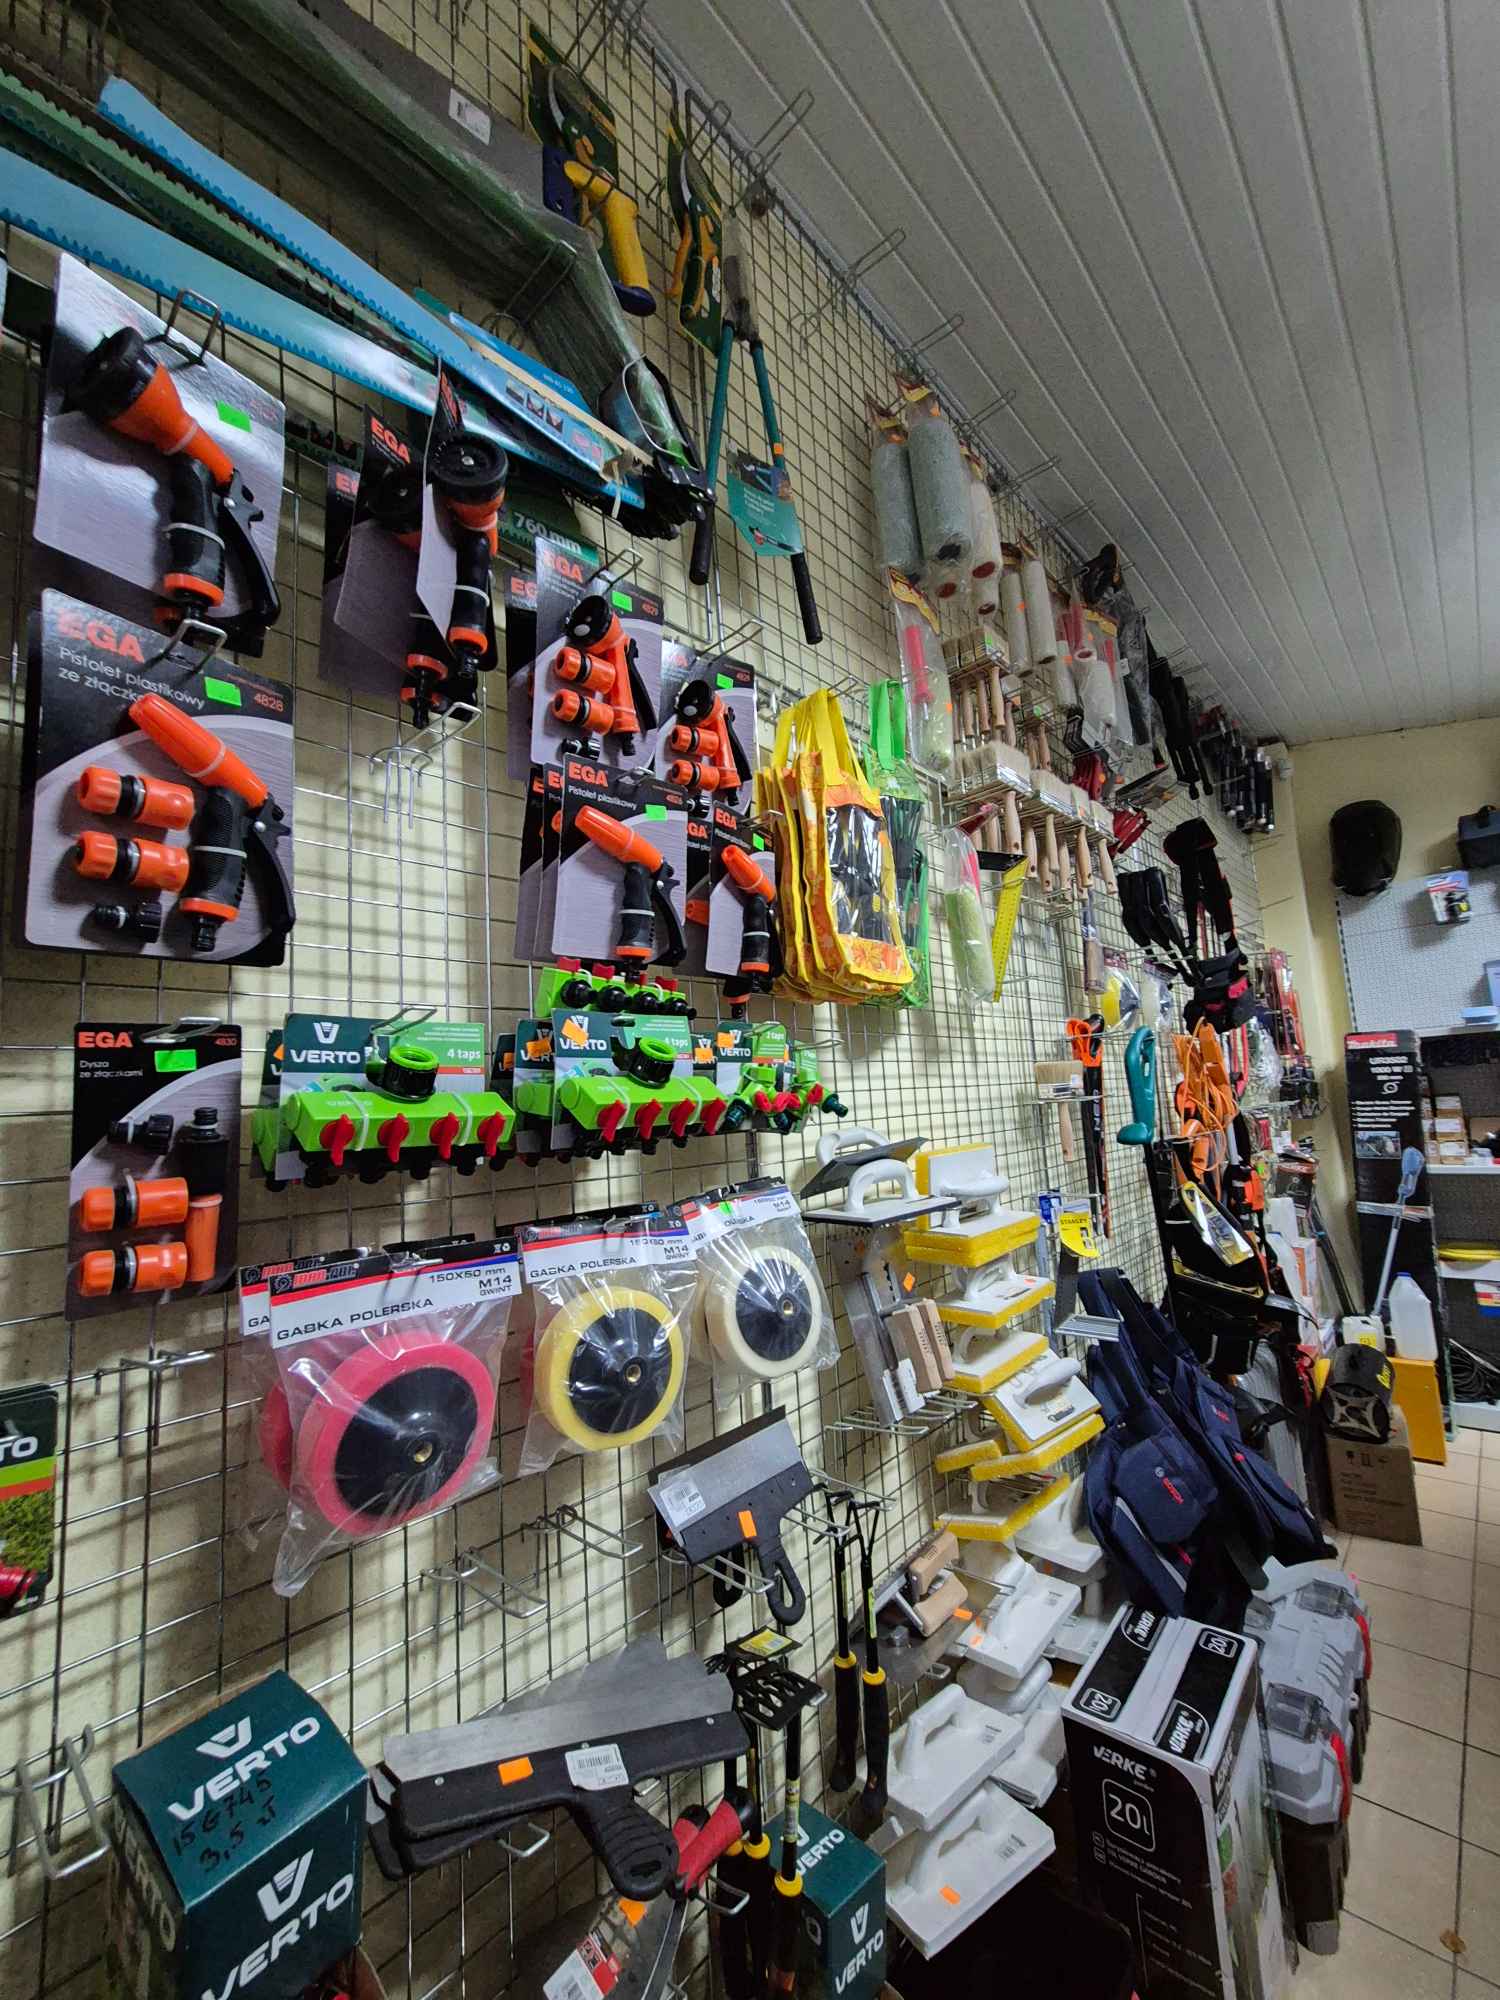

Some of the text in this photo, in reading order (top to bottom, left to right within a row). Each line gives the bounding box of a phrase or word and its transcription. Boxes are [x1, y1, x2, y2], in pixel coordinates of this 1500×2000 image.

[370, 415, 411, 465] EGA
[513, 511, 548, 537] 760
[57, 607, 145, 664] EGA
[58, 667, 146, 704] ze złączk
[59, 646, 122, 680] Pistolet
[126, 672, 206, 711] plastikowy
[568, 761, 609, 787] EGA
[568, 785, 638, 811] Pistolet plastikowy
[715, 807, 738, 830] EGA
[78, 1032, 133, 1049] EGA
[559, 1038, 608, 1051] VERTO
[720, 1047, 752, 1057] VERTO
[80, 1060, 110, 1069] Dysza
[290, 1049, 361, 1065] VERTO
[447, 1048, 482, 1061] 4 taps
[479, 1275, 513, 1290] M14
[350, 1298, 434, 1323] POLERSKA
[167, 1716, 321, 1821] VERTO
[1093, 1745, 1148, 1781] VERKE
[796, 1828, 846, 1876] VERTO
[201, 1872, 355, 2000] VERTO
[835, 1928, 885, 1995] VERTO
